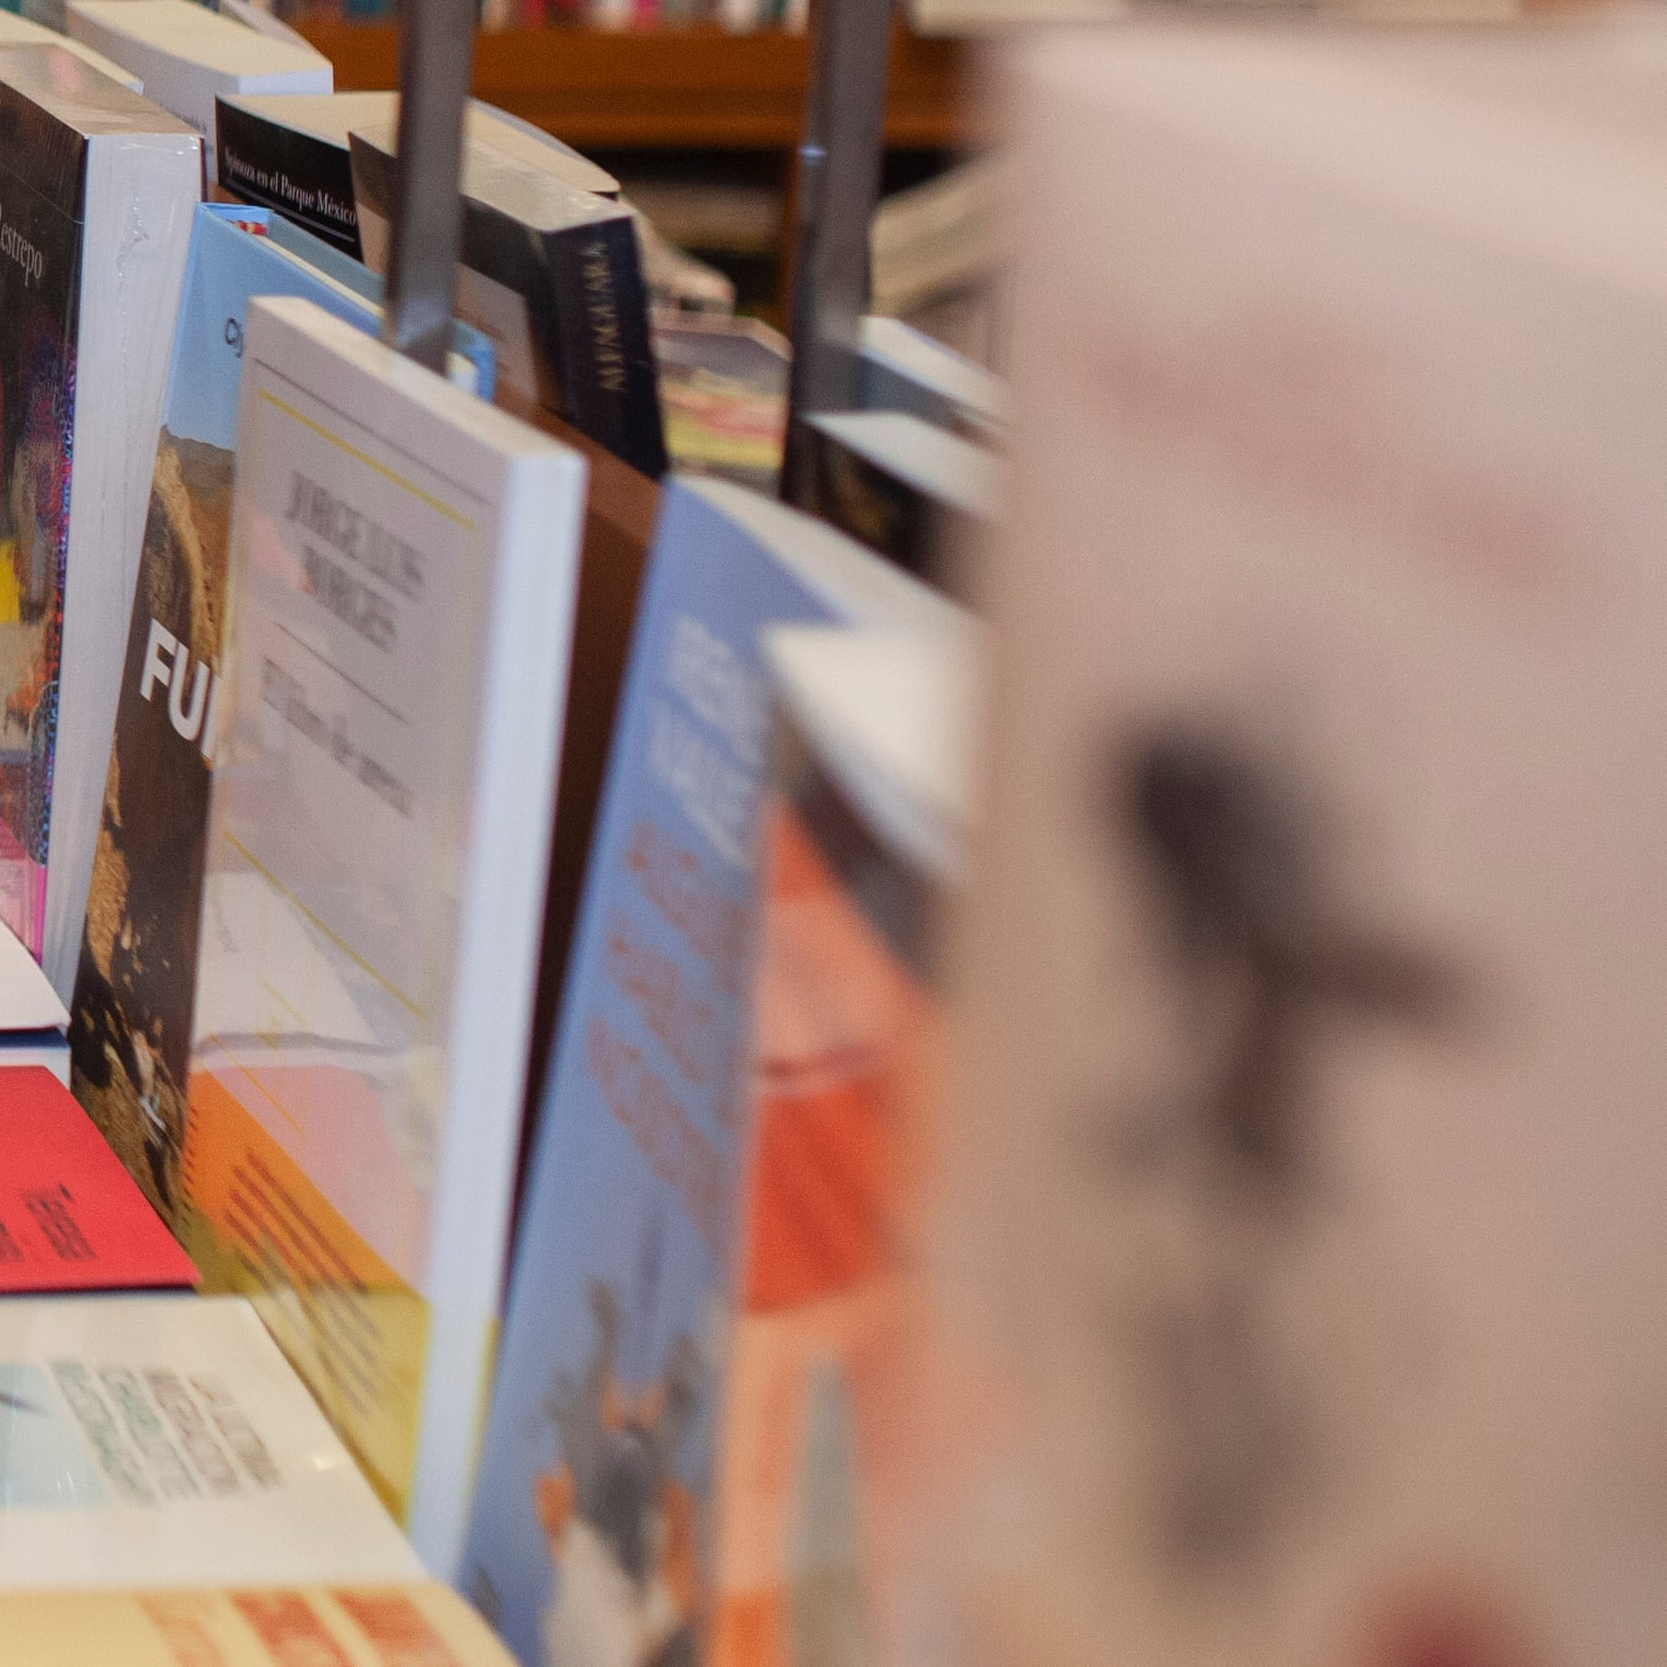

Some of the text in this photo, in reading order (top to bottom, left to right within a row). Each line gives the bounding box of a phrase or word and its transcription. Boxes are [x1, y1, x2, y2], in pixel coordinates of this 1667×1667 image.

[257, 168, 268, 189] en
[269, 170, 280, 194] el
[281, 174, 315, 212] Parque
[316, 190, 357, 227] México
